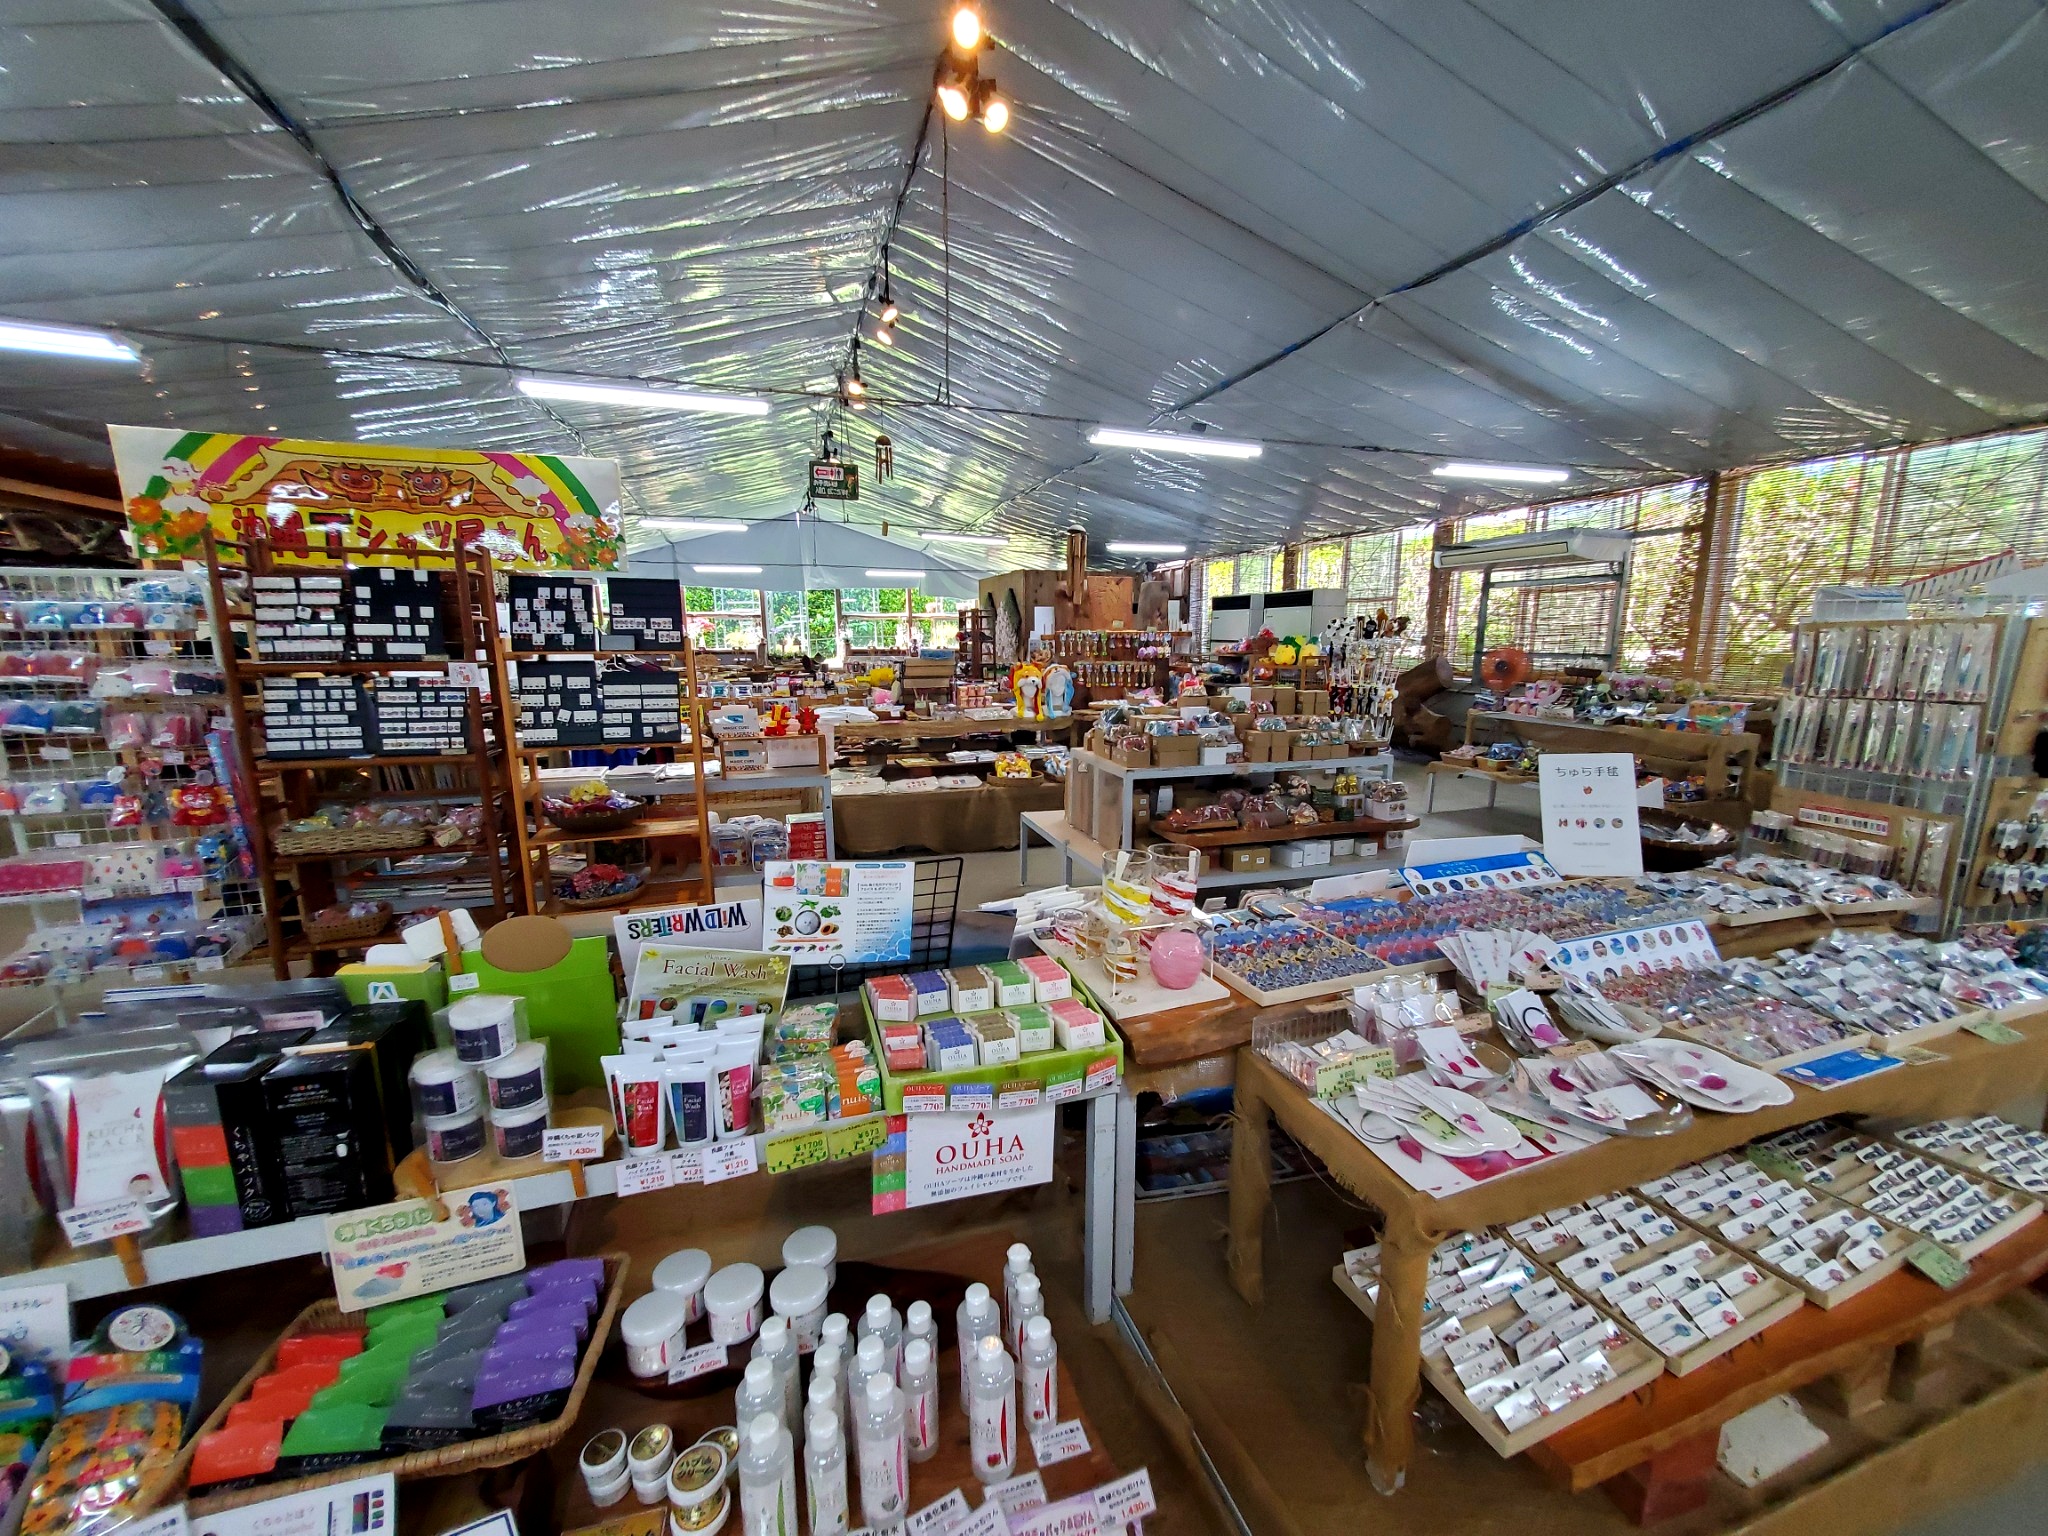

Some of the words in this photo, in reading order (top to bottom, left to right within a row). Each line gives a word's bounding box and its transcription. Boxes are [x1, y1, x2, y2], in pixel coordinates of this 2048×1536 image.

[662, 959, 716, 977] Facial
[723, 962, 767, 980] Wash
[569, 1147, 597, 1156] 1,430円
[935, 1134, 1025, 1165] OUHA
[936, 1158, 996, 1175] HANDMADE
[999, 1152, 1025, 1164] SOAP
